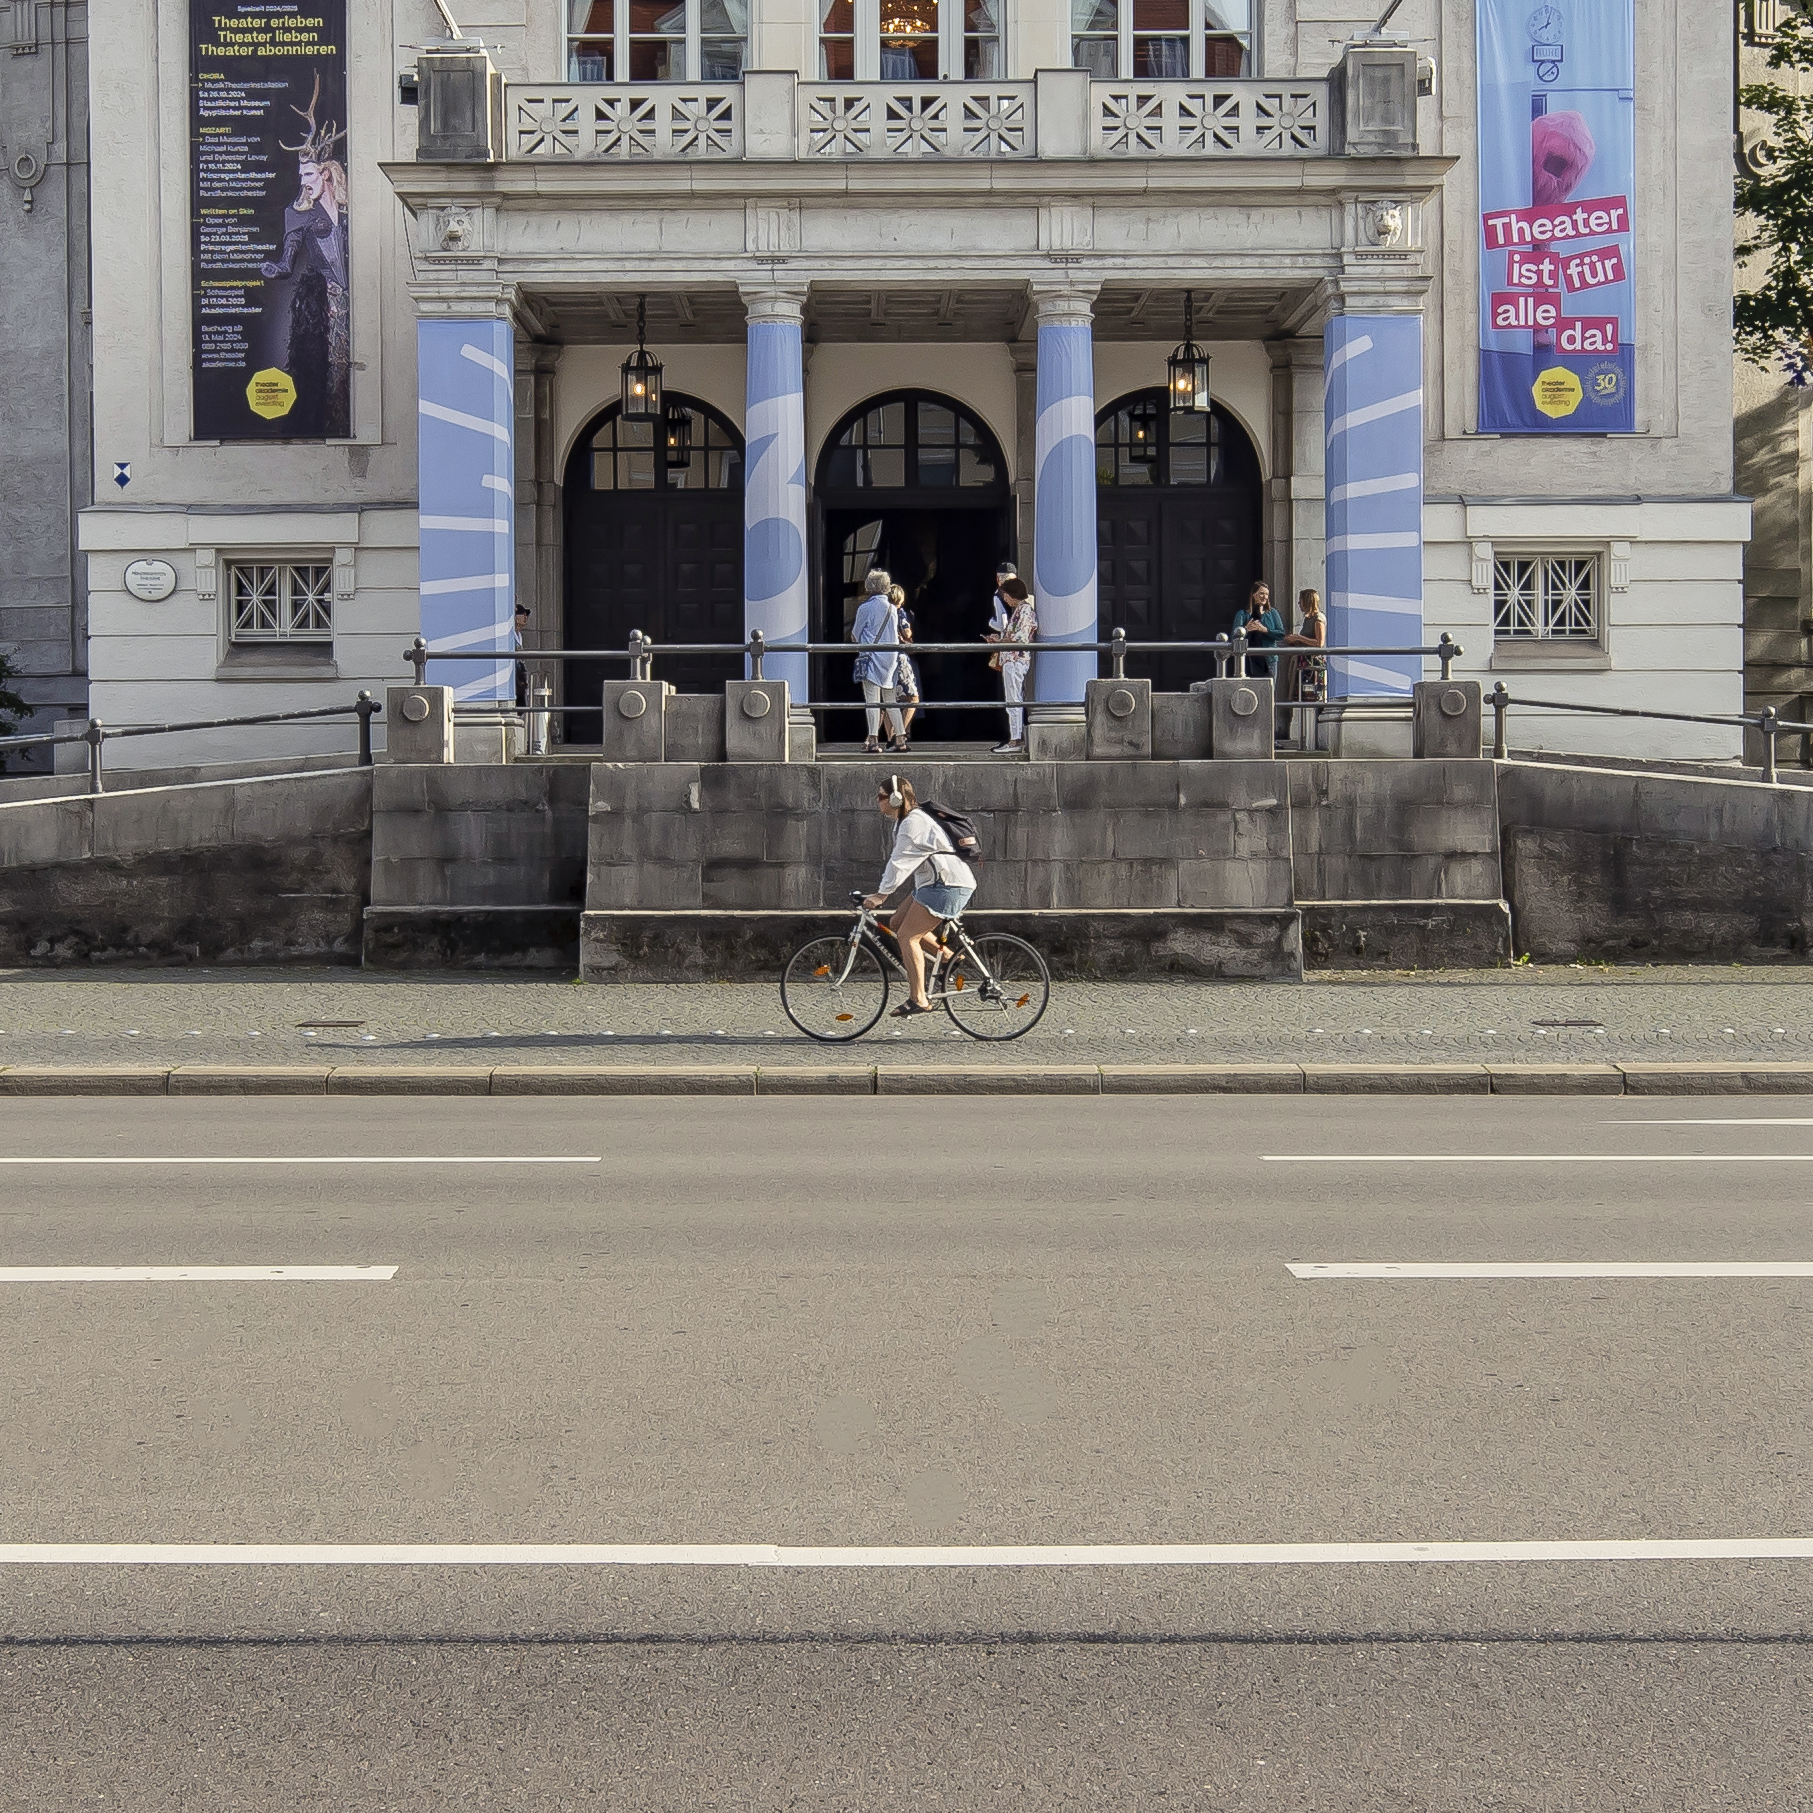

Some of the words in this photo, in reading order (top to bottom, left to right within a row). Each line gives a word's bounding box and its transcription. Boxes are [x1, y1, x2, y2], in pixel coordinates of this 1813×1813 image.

[212, 15, 268, 28] Theater
[270, 15, 324, 28] erleben
[217, 30, 273, 43] Theater
[275, 29, 318, 42] lieben
[199, 43, 255, 56] Theater
[257, 43, 337, 56] abonnieren
[1487, 206, 1624, 245] Theater
[1512, 253, 1555, 286] ist
[1566, 253, 1619, 290] für
[1496, 296, 1557, 327] alle
[1560, 320, 1614, 351] da!
